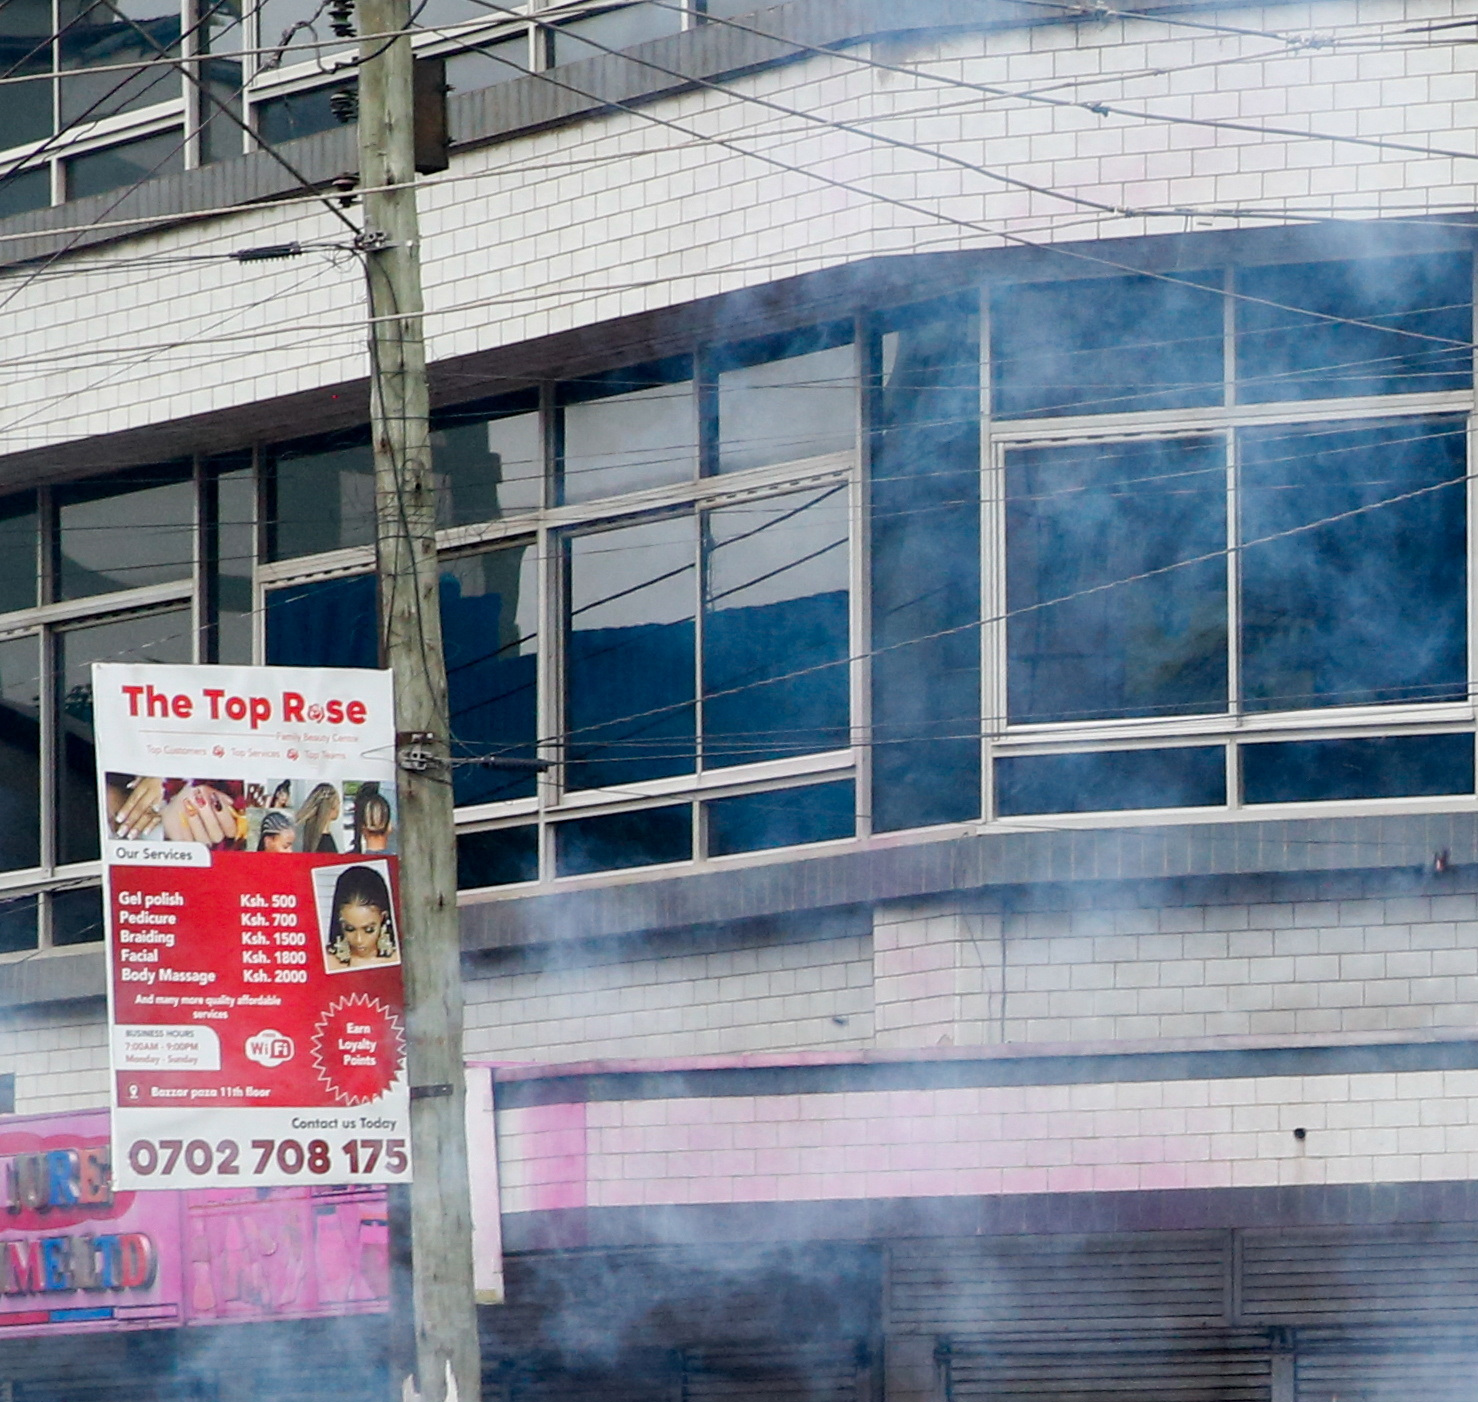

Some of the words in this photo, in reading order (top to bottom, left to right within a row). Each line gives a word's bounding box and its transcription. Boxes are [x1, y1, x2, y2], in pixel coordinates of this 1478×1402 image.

[122, 684, 194, 719] The
[202, 688, 272, 730] Top
[303, 732, 330, 744] Beauty
[146, 745, 161, 756] Top
[163, 745, 207, 756] Customers
[231, 747, 246, 759] Top
[248, 748, 281, 758] Services
[304, 750, 321, 761] Top
[115, 847, 138, 859] Our
[143, 848, 193, 860] Services
[118, 891, 142, 906] Gel
[145, 892, 184, 908] polish
[240, 894, 269, 908] Ksh.
[272, 895, 297, 908] 500
[119, 911, 177, 925] Pedicure
[241, 913, 270, 927] Ksh.
[272, 914, 297, 927] 700
[119, 929, 175, 947] Braiding
[241, 932, 271, 945] Ksh.
[273, 932, 306, 946] 1500
[120, 948, 159, 962] Facial
[242, 950, 272, 964] Ksh.
[274, 951, 307, 964] 1800
[121, 967, 156, 984] Body
[159, 969, 216, 985] Massage
[243, 969, 272, 983] Ksh.
[274, 970, 308, 983] 2000
[135, 994, 154, 1005] And
[155, 996, 180, 1008] many
[181, 997, 203, 1006] more
[205, 995, 235, 1008] quality
[237, 995, 281, 1006] affordable
[192, 1009, 229, 1019] services
[125, 1030, 164, 1038] BUSINESS
[166, 1030, 195, 1038] HOURS
[346, 1022, 371, 1034] Earn
[338, 1037, 377, 1053] Loyalty
[125, 1054, 160, 1066] Monday
[167, 1054, 199, 1066] Sunday
[343, 1055, 378, 1066] Points
[220, 1086, 243, 1097] 11th
[245, 1086, 271, 1097] floor
[292, 1117, 338, 1130] Contact
[342, 1120, 356, 1130] us
[360, 1117, 397, 1131] Today
[129, 1138, 240, 1176] 0702
[251, 1138, 331, 1175] 708
[342, 1138, 408, 1175] 175
